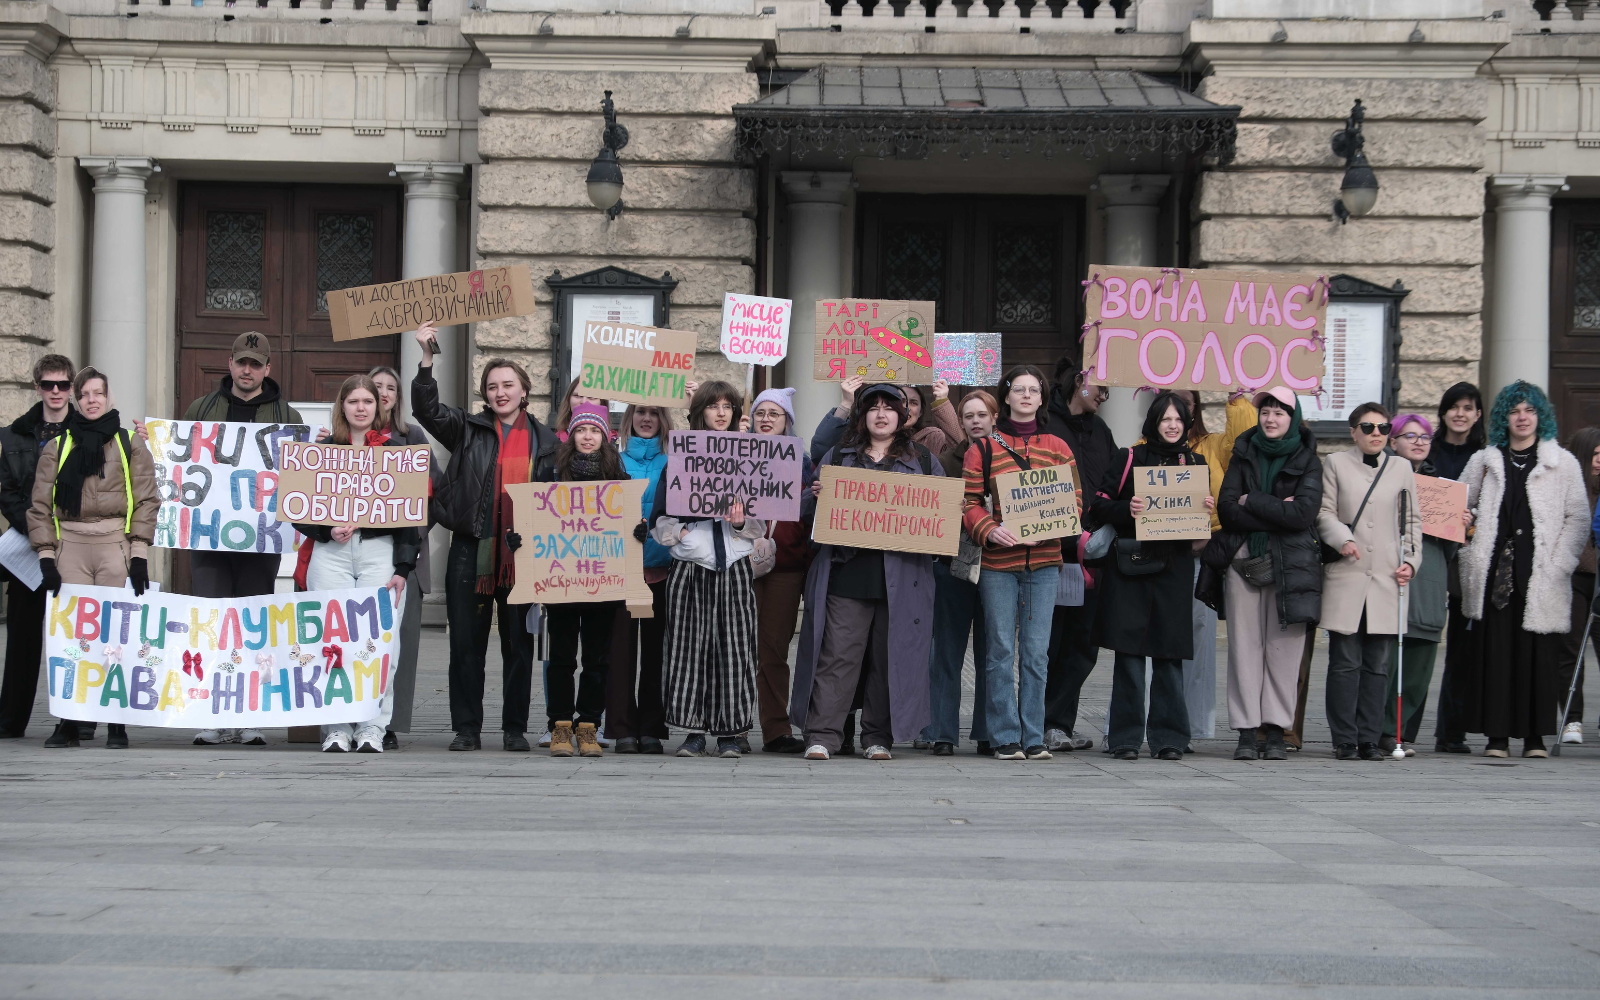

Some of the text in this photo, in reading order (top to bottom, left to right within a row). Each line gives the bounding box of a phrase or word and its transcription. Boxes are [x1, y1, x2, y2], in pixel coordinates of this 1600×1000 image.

[345, 290, 365, 308] ЧИ
[369, 275, 457, 303] ДОСТАТНЬО
[467, 269, 484, 298] Я
[1101, 276, 1208, 323] ВОНА
[1224, 280, 1317, 330] МАЄ
[586, 323, 657, 351] КОДЕКС
[822, 338, 868, 358] НИЦ
[651, 350, 694, 370] МАЄ
[1096, 327, 1319, 390] ГОЛОС
[581, 362, 686, 400] ЗАХИЩАТИ
[146, 420, 246, 467] РУКИ
[673, 435, 796, 461] НЕ ПОТЕРПІЛА
[283, 443, 429, 474] КОЖНА МАЄ
[684, 455, 773, 480] ПРОВОКУЄ,
[316, 471, 395, 497] ПРАВО
[670, 475, 794, 500] А НАСИЛЬНИК
[1011, 482, 1074, 501] ПАРТНЕРСТВА
[1018, 469, 1058, 487] КОЛИ
[1146, 469, 1168, 487] 14
[533, 481, 623, 519] КОДЕКС
[834, 478, 941, 509] ПРАВА ЖІНОК
[1145, 495, 1192, 511] ЖІНКА
[282, 491, 424, 524] ОБИРАТИ
[561, 517, 604, 533] МАЄ
[829, 507, 946, 539] НЕ КОМПРОМІС
[533, 530, 625, 561] ЗАХИЩАТИ
[549, 559, 607, 574] А НЕ
